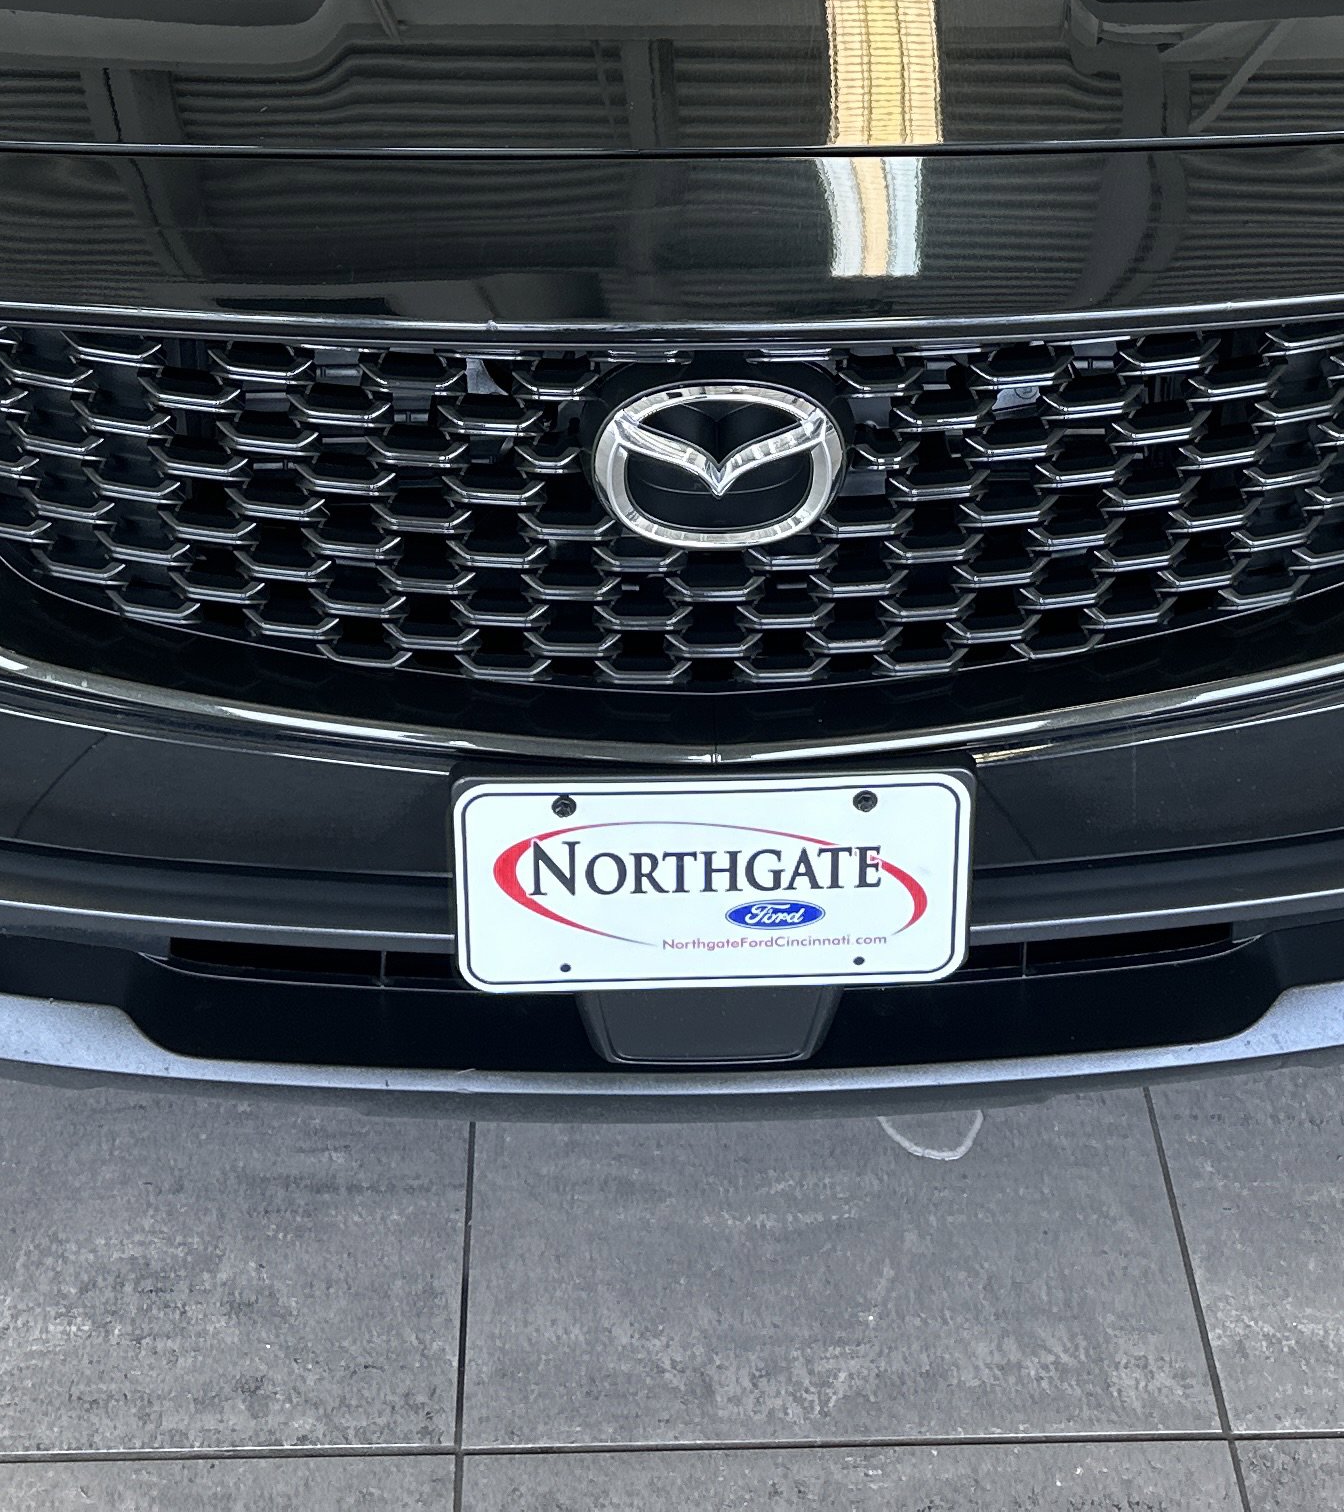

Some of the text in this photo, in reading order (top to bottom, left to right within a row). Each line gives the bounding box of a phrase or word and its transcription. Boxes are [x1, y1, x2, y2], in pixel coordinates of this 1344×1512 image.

[528, 839, 883, 897] NORTHGATE
[744, 901, 806, 926] Ford
[662, 932, 888, 952] NorthgateFordCincinnati.com
